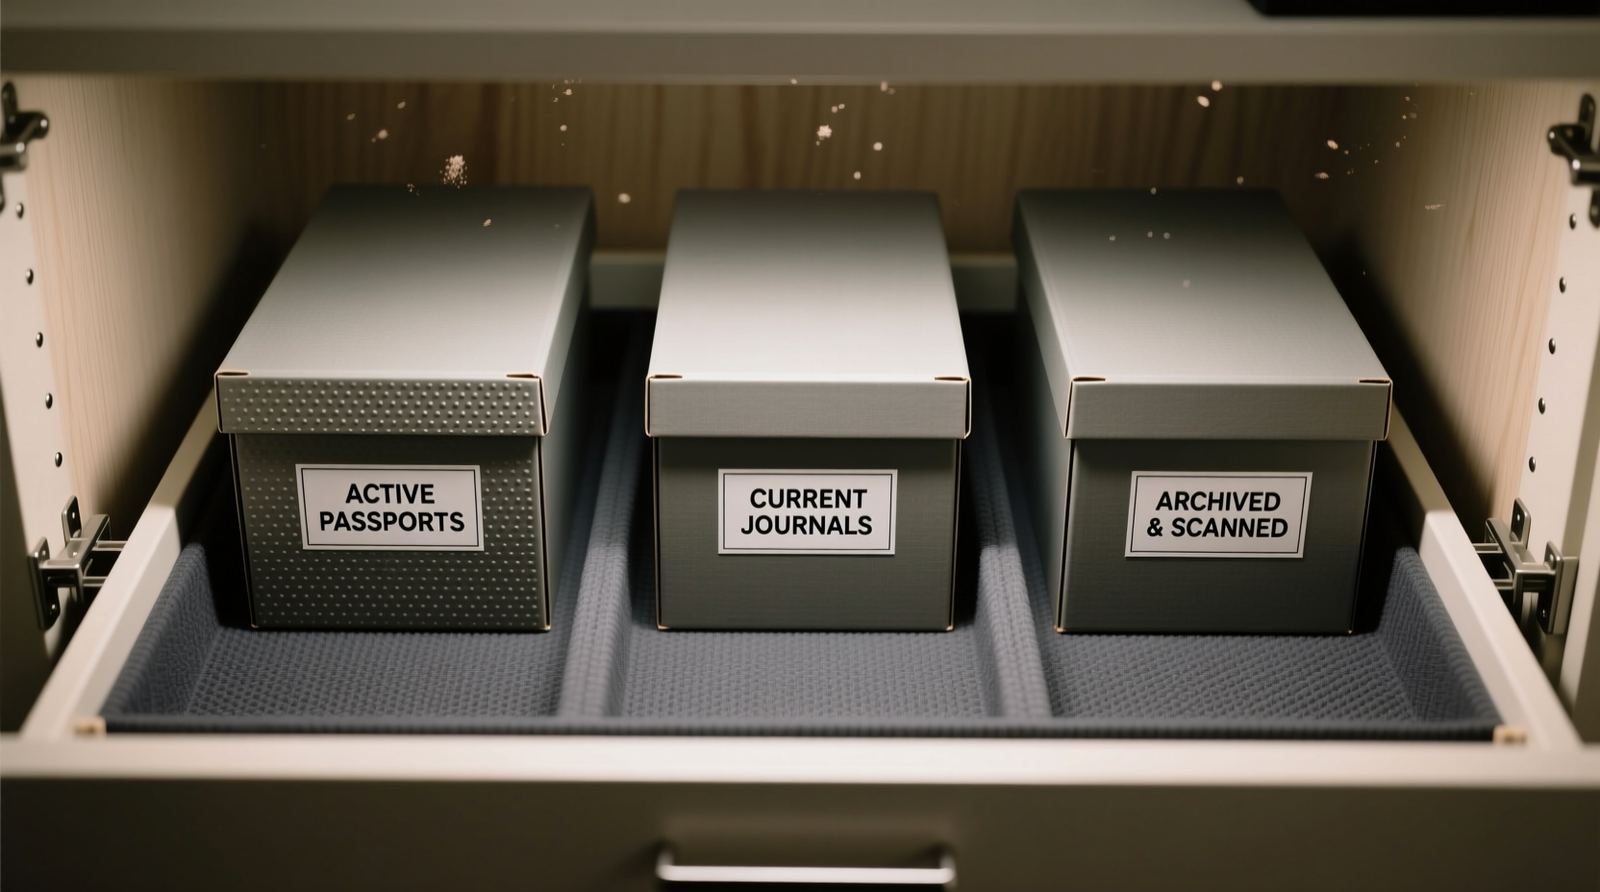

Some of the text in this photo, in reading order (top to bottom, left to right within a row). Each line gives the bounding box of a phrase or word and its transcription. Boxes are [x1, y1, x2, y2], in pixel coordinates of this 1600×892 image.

[345, 483, 436, 505] ACTIVE
[750, 488, 868, 509] CURRENT
[1155, 490, 1281, 512] ARCHIVED
[319, 510, 465, 533] PASSPORTS
[740, 514, 873, 536] JOURNALS
[1146, 516, 1289, 538] & SCANNED
